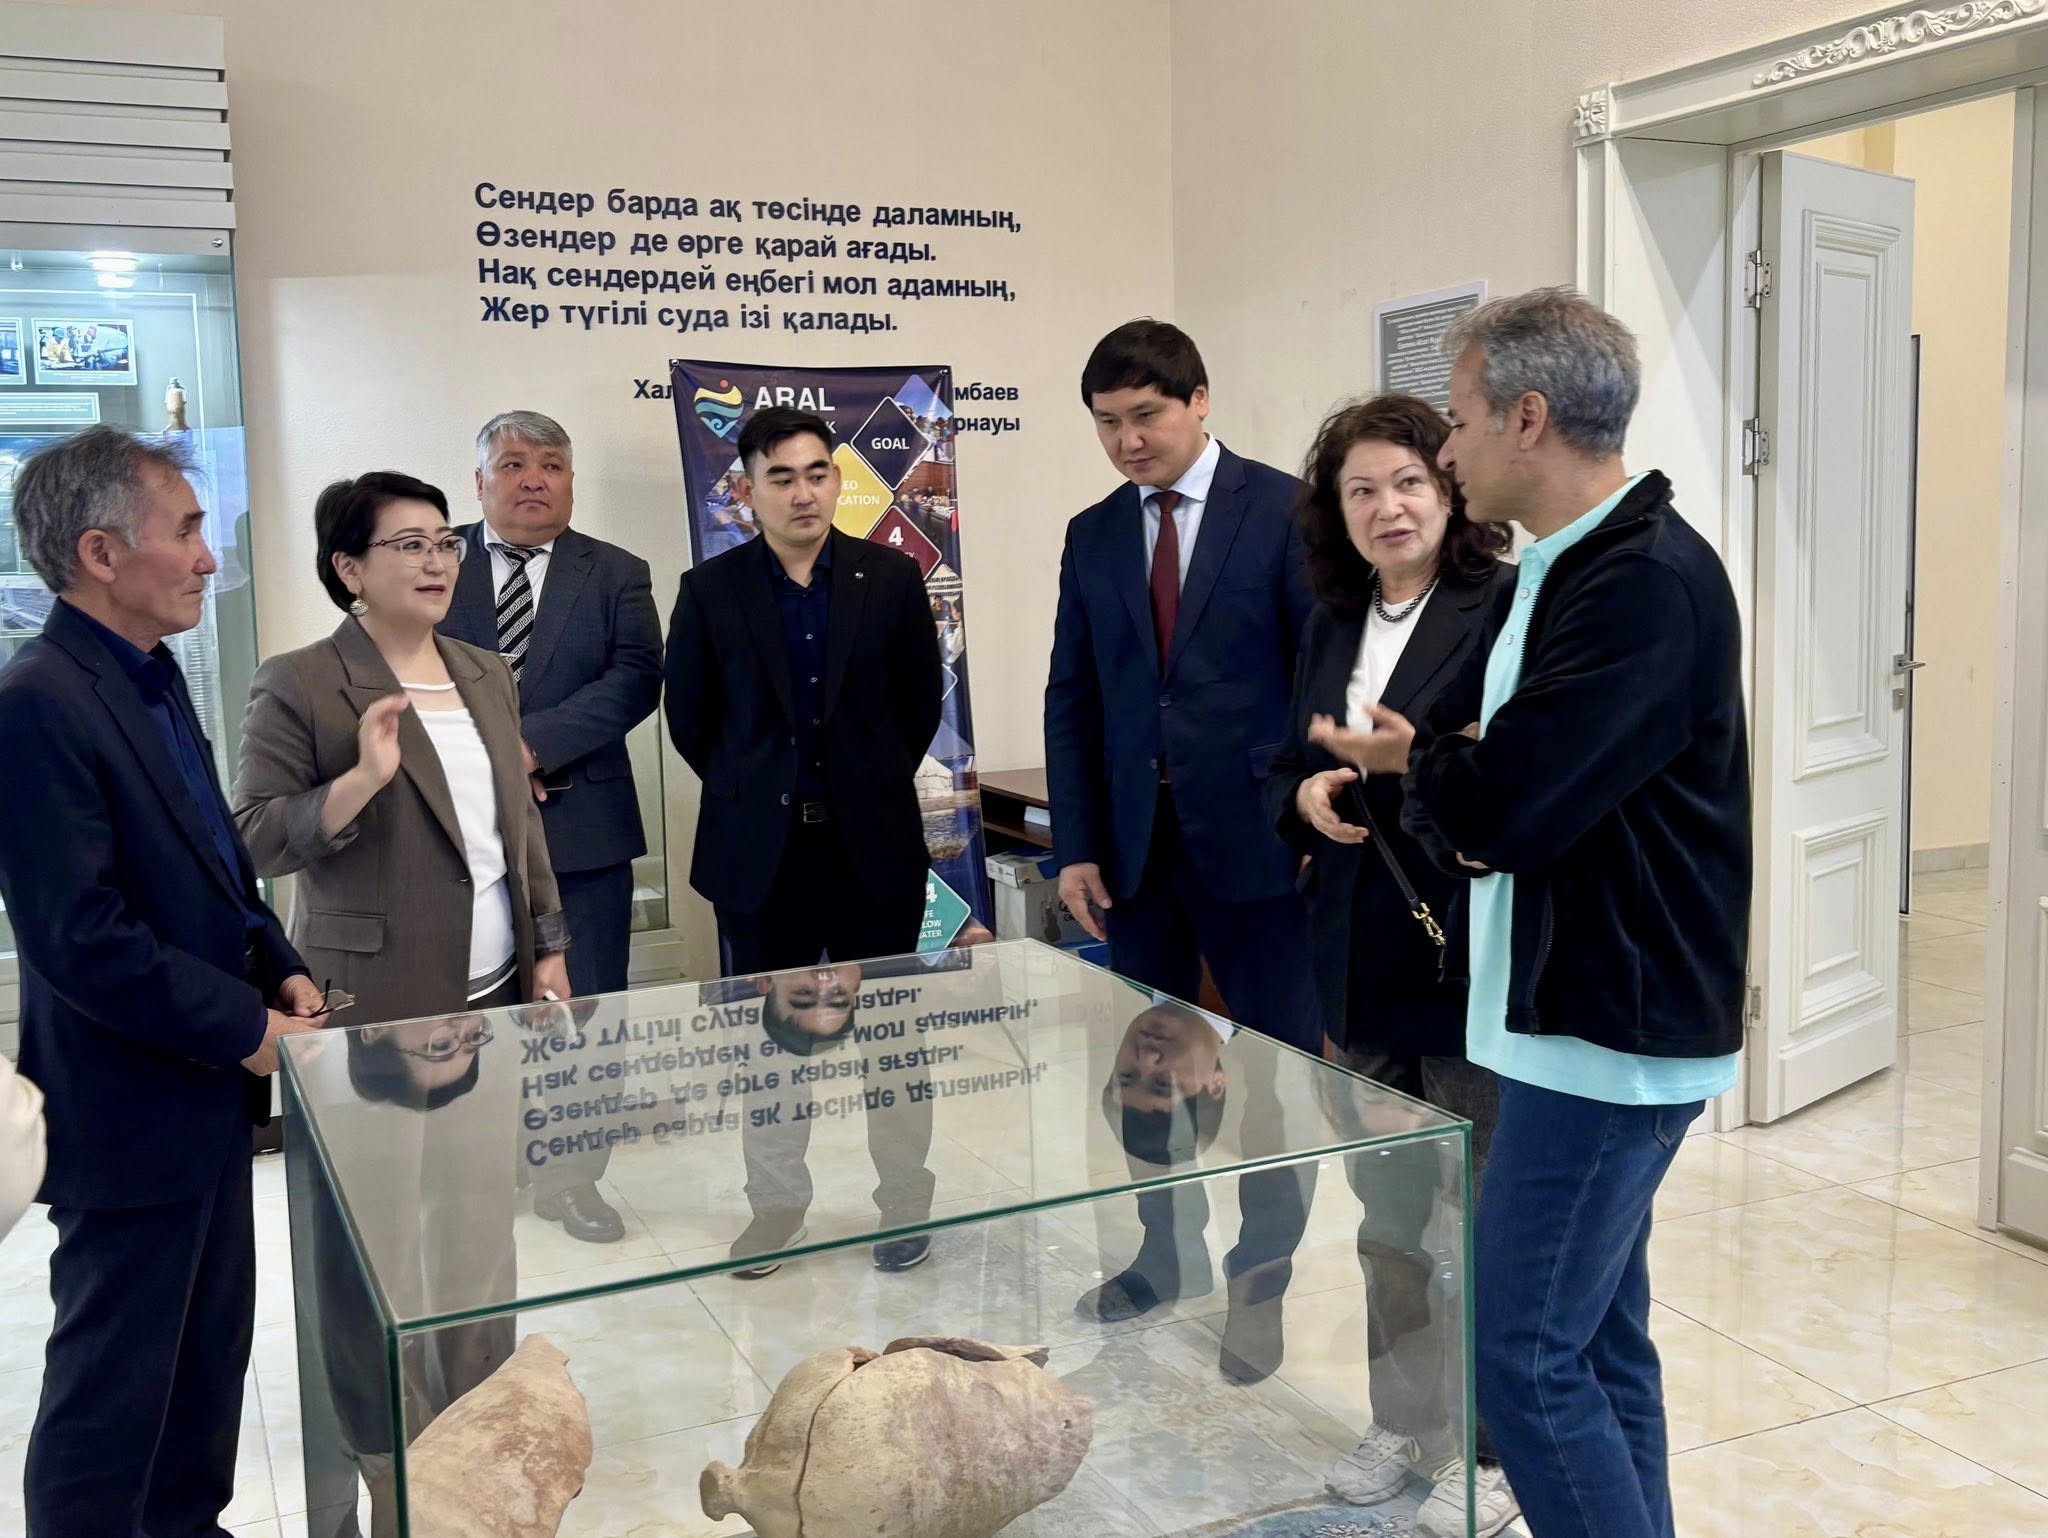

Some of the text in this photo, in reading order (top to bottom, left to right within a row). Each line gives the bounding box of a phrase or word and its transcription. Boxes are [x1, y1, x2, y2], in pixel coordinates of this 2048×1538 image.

[474, 182, 1021, 233] Сендер барда ақ төсінде даламның,
[476, 220, 937, 265] Өзендер де өрге қарай ағады.
[478, 257, 1016, 302] Нақ сендердей еңбегі мол адамның,
[479, 295, 898, 335] Жер түгілі суда ізі қалады.
[753, 386, 836, 411] ARAL
[954, 382, 1019, 401] мбаев
[954, 417, 1020, 436] рнауы
[871, 437, 911, 450] GOAL
[842, 480, 859, 490] EO
[838, 495, 880, 505] CATION
[888, 526, 904, 546] 4
[925, 882, 938, 903] 4
[921, 919, 942, 929] LOW
[919, 929, 943, 939] ATER
